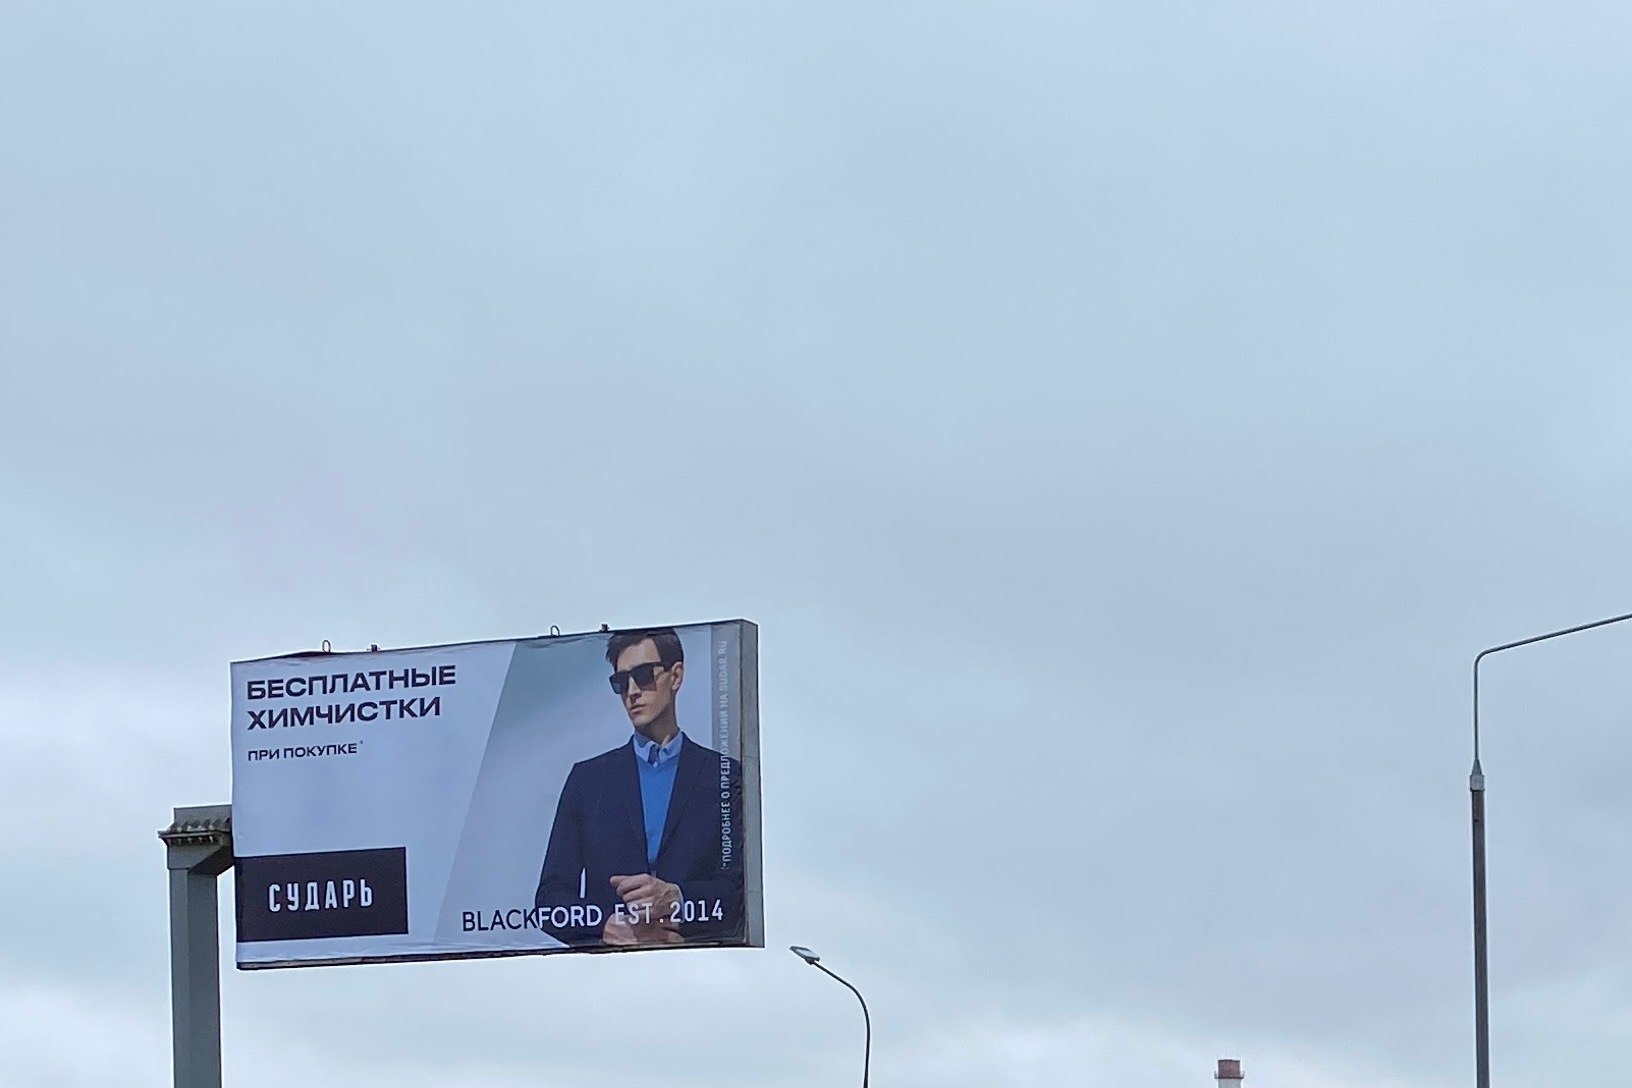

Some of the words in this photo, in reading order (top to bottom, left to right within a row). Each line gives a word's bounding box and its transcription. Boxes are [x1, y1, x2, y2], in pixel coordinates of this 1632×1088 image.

[247, 665, 456, 700] БЕСПЛАТНЫЕ
[247, 697, 441, 730] ХИМЧИСТКИ
[720, 694, 728, 708] НА
[248, 748, 280, 761] ПРИ
[720, 711, 730, 789] ПРЕДЛОЖЕНИИ
[721, 791, 730, 799] О
[268, 879, 373, 912] СУДАРЬ
[462, 904, 602, 931] BLACKFORD
